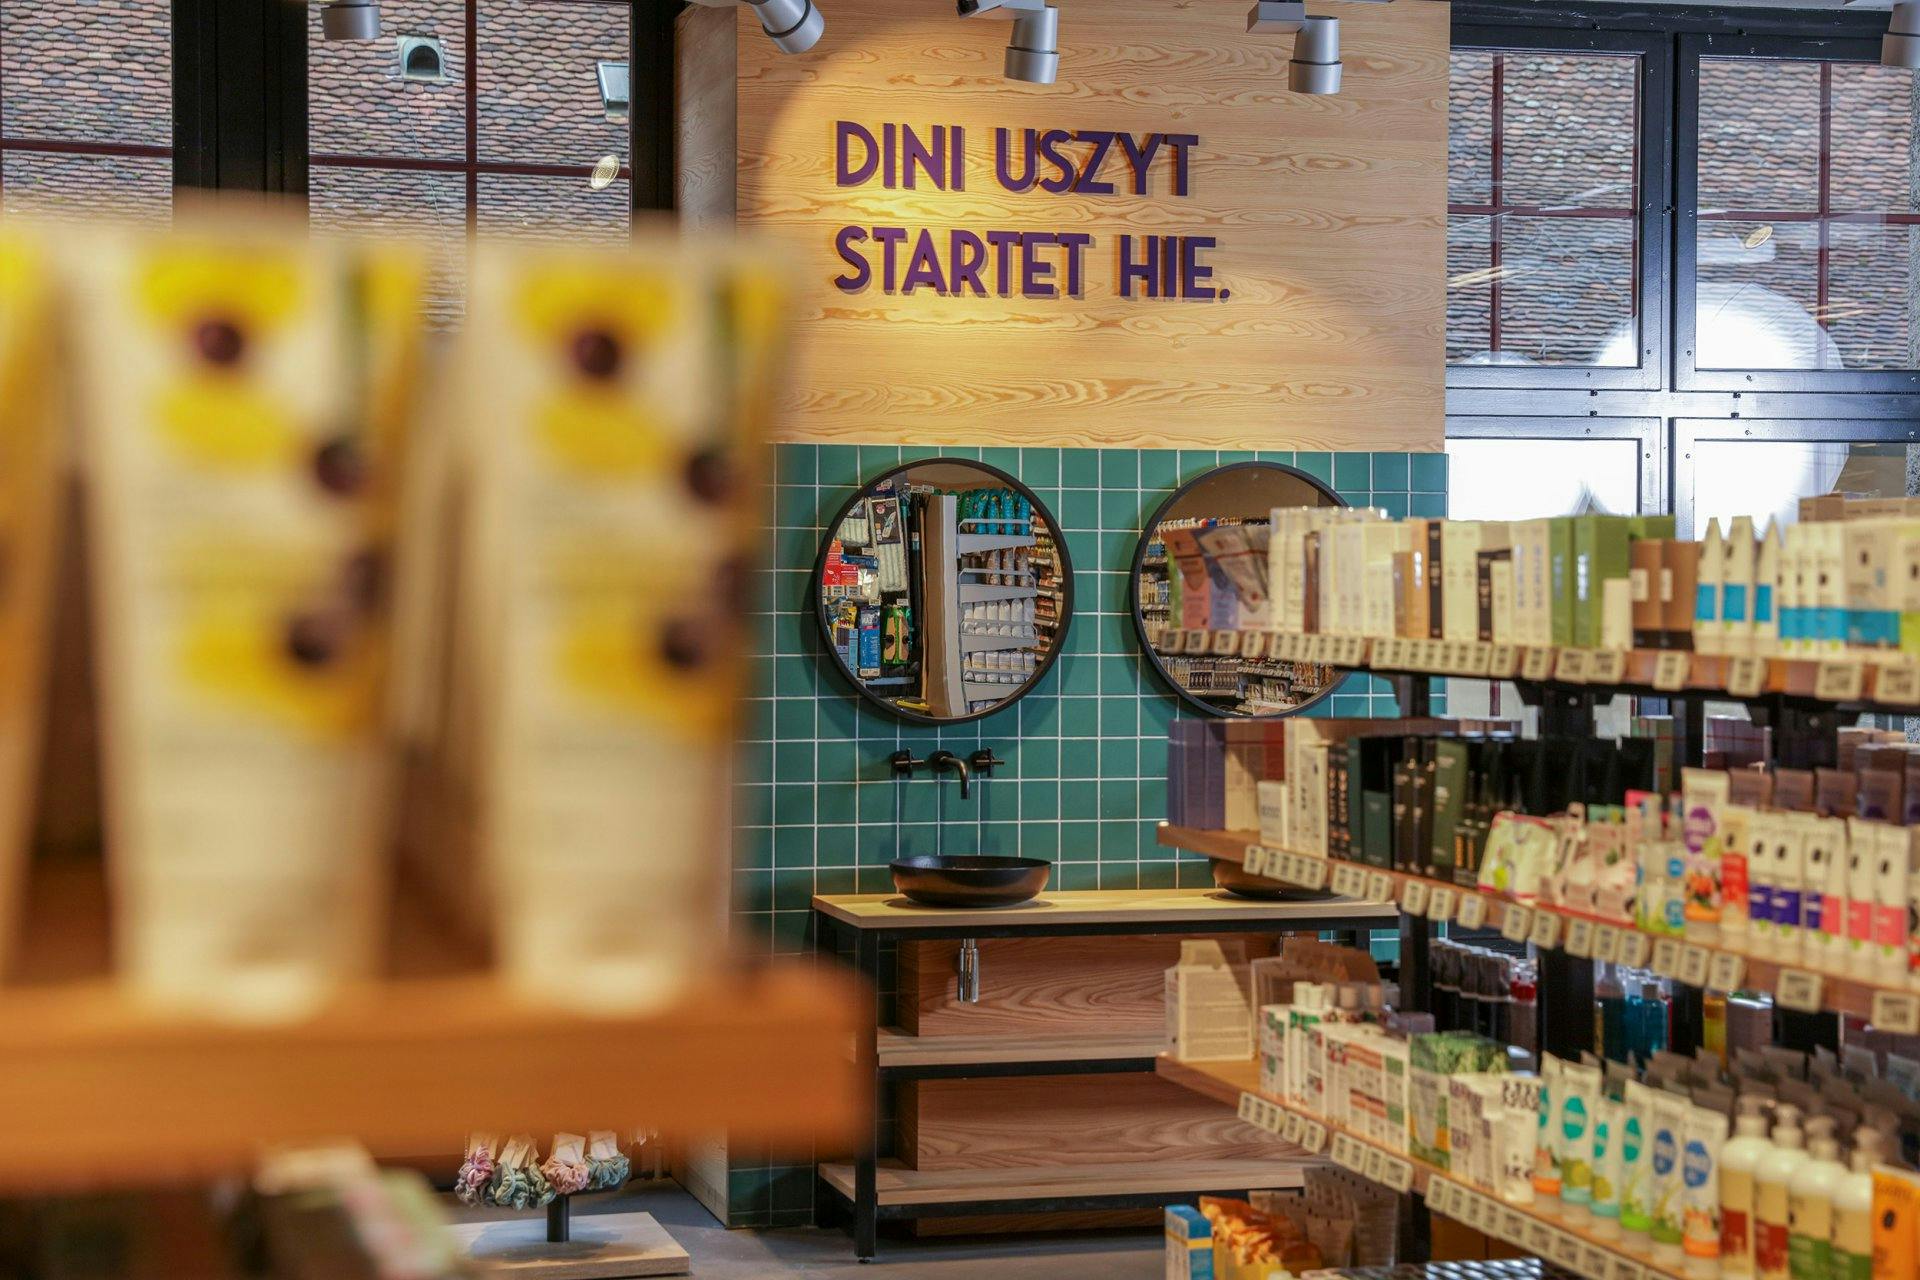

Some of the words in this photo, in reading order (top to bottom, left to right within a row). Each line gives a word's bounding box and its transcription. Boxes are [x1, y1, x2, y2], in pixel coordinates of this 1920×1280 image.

[836, 121, 964, 191] DINI
[996, 127, 1199, 196] USZYT
[834, 225, 1090, 297] STARTET
[1120, 234, 1231, 299] HIE.
